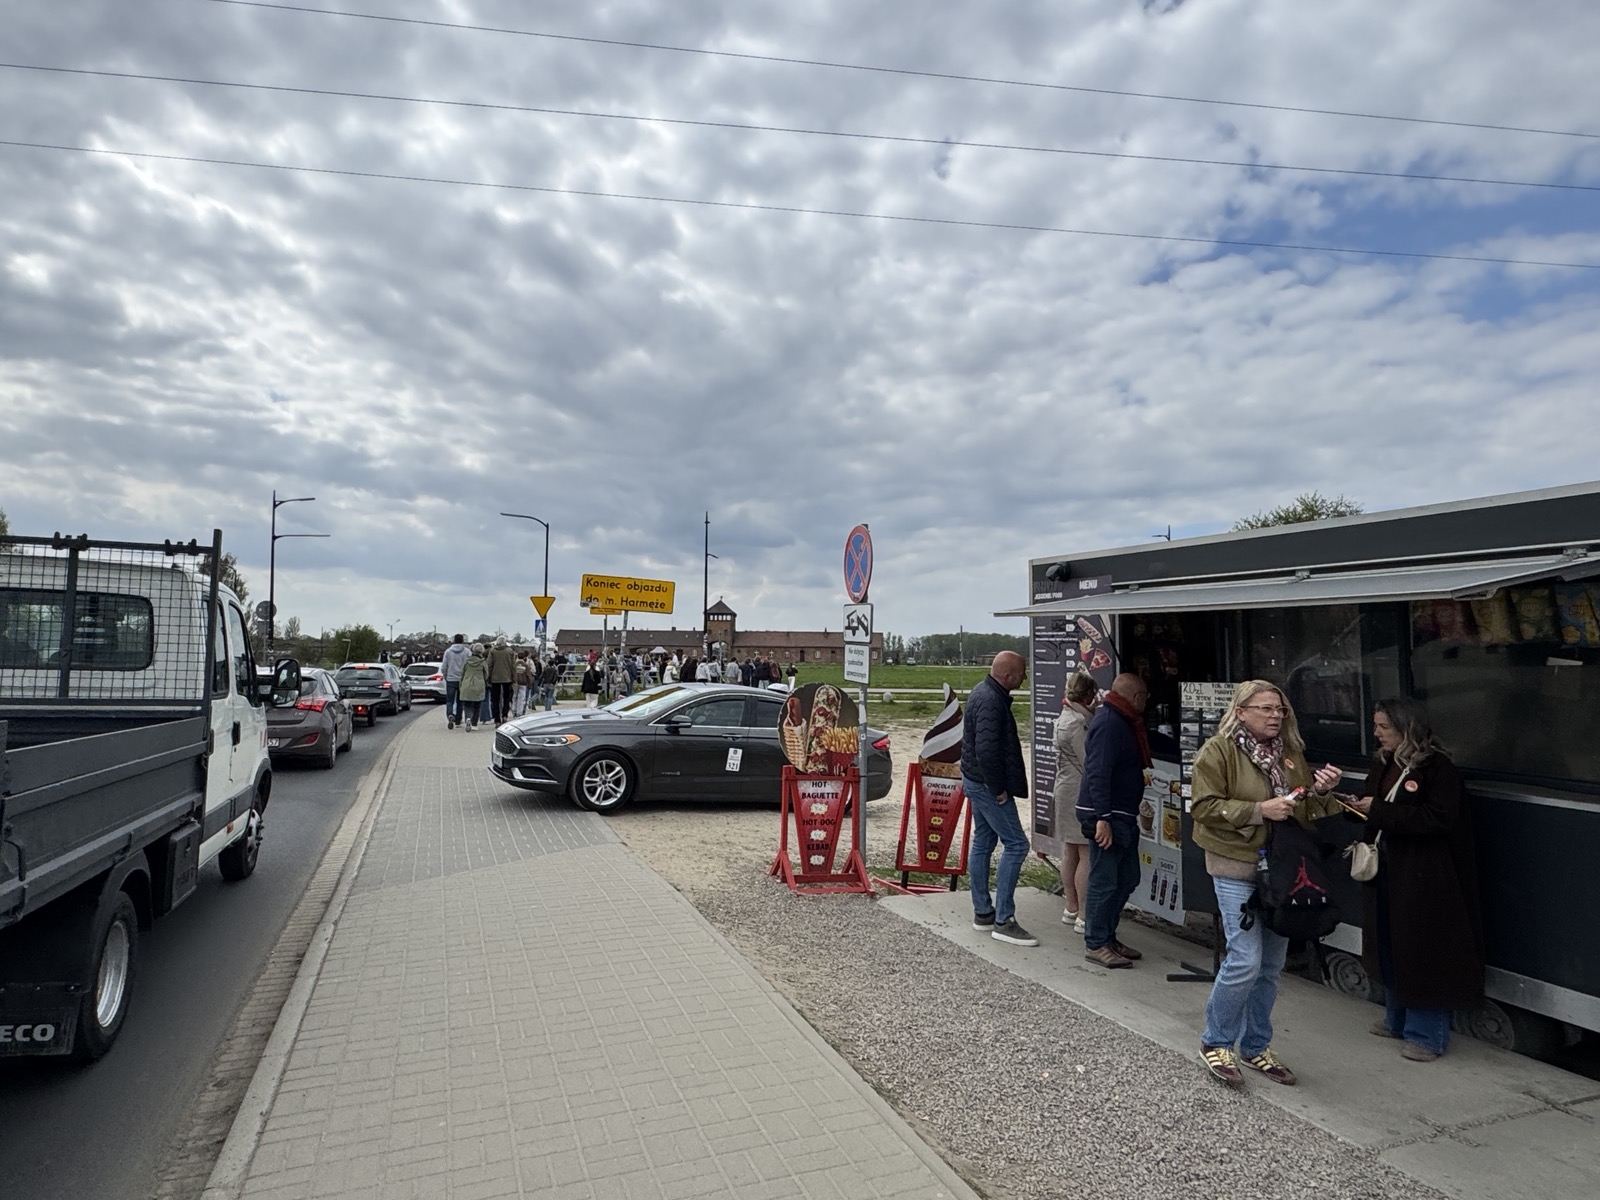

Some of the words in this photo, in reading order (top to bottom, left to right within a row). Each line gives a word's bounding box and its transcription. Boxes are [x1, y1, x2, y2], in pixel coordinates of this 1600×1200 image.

[586, 577, 621, 590] Koniec
[626, 581, 668, 594] objazdu
[1079, 579, 1098, 590] MENU
[604, 596, 617, 606] m.
[620, 596, 666, 610] Harmęże
[926, 782, 957, 790] CHOCOLATE
[806, 843, 830, 851] KEBAB
[1291, 896, 1327, 905] AIR
[0, 1023, 55, 1042] ECO
